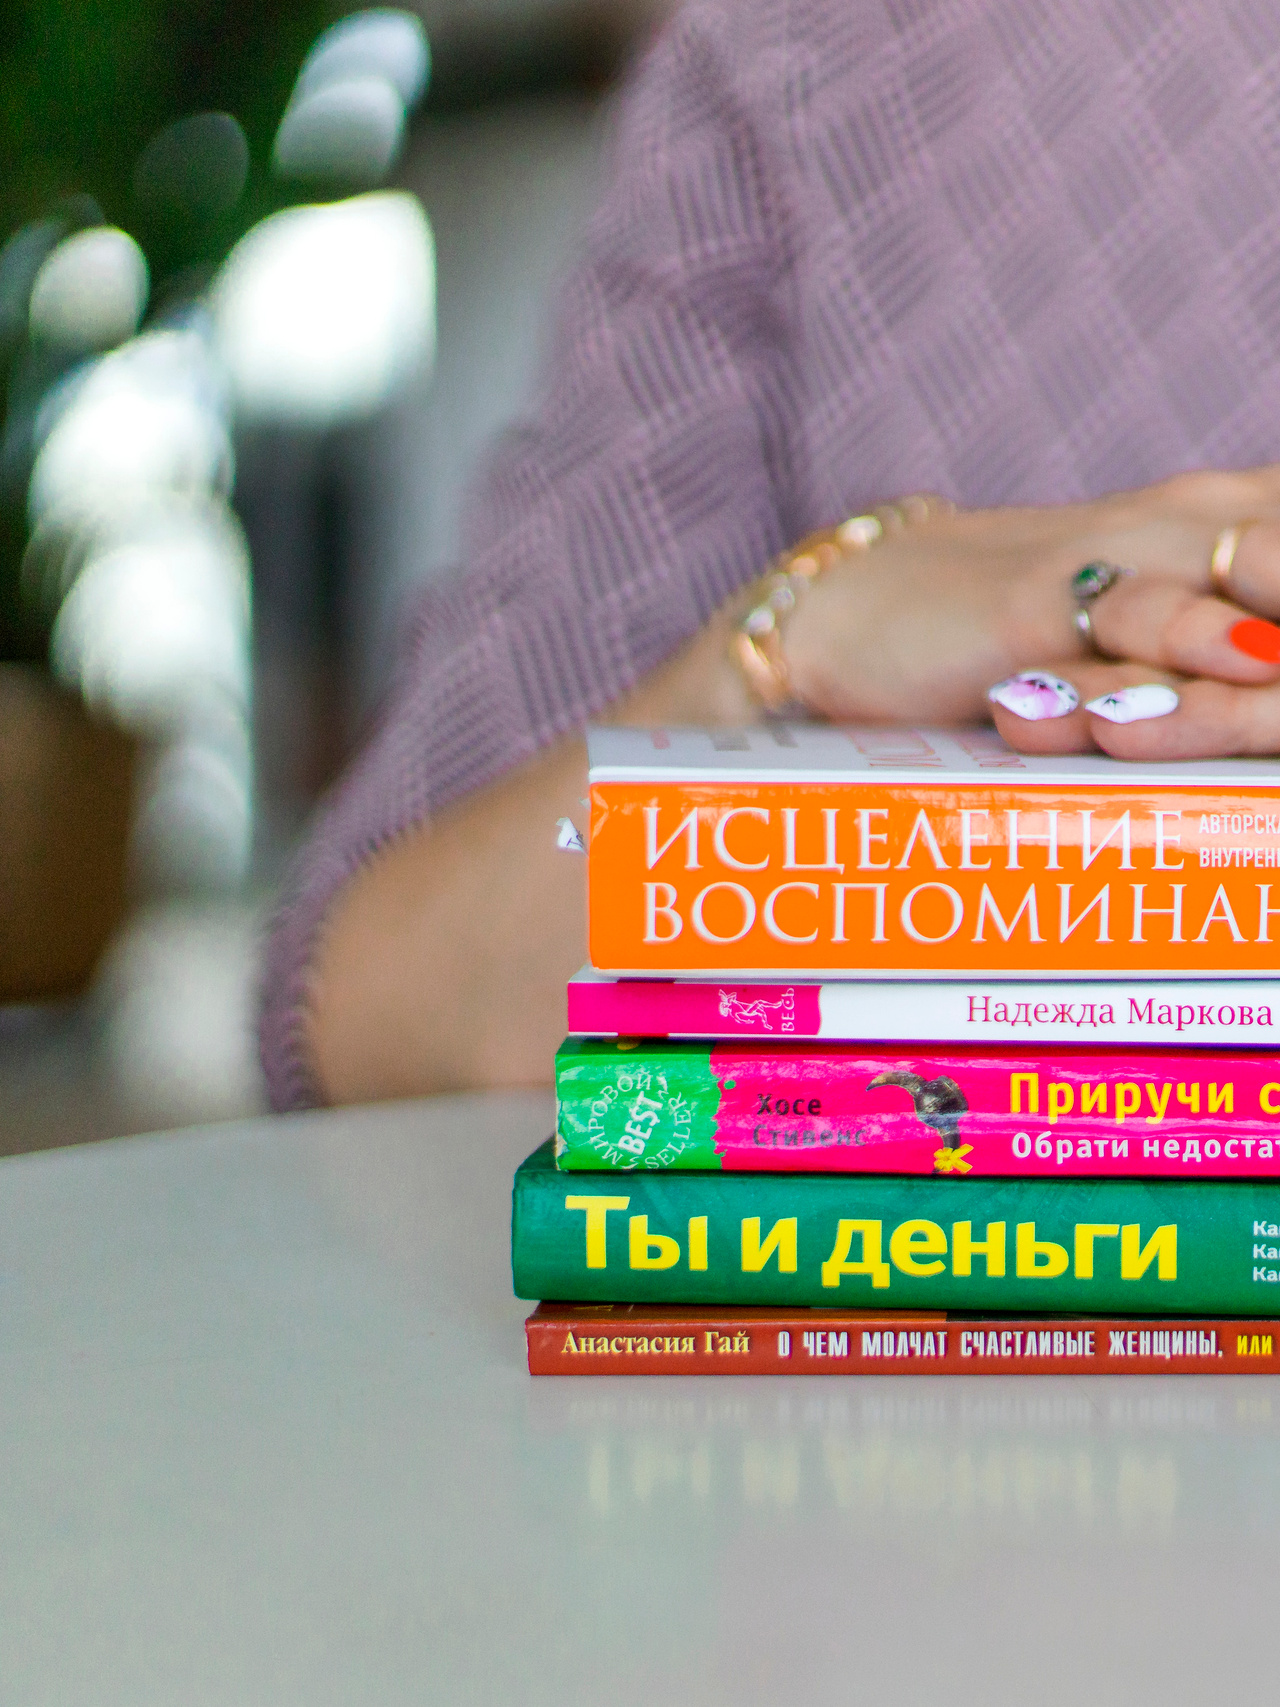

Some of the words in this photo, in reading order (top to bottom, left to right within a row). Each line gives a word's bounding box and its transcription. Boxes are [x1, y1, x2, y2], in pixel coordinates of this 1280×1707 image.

[641, 806, 1185, 876] ИСЦЕЛЕНИЕ
[781, 987, 795, 1032] ВЕСЬ
[966, 995, 1115, 1028] Надежда
[1127, 997, 1274, 1031] Маркова
[588, 1068, 656, 1167] МИРОВОЙ
[756, 1093, 822, 1116] Хосе
[1010, 1072, 1235, 1125] Приручи
[617, 1090, 664, 1156] BEST
[644, 1091, 693, 1170] SELLER
[752, 1123, 868, 1147] Стивенс
[1012, 1132, 1131, 1164] Обрати
[564, 1194, 710, 1271] Ты
[740, 1215, 799, 1274] и
[820, 1218, 1179, 1290] деньги
[561, 1331, 695, 1354] Анастасия
[704, 1331, 750, 1353] Гай
[778, 1330, 791, 1357] О
[803, 1330, 849, 1357] ЧЕМ
[861, 1330, 948, 1358] МОЛЧАТ
[960, 1330, 1096, 1358] СЧАСТЛИВЫЕ
[1108, 1330, 1223, 1359] ЖЕНЩИНЫ,
[1236, 1333, 1273, 1357] или
